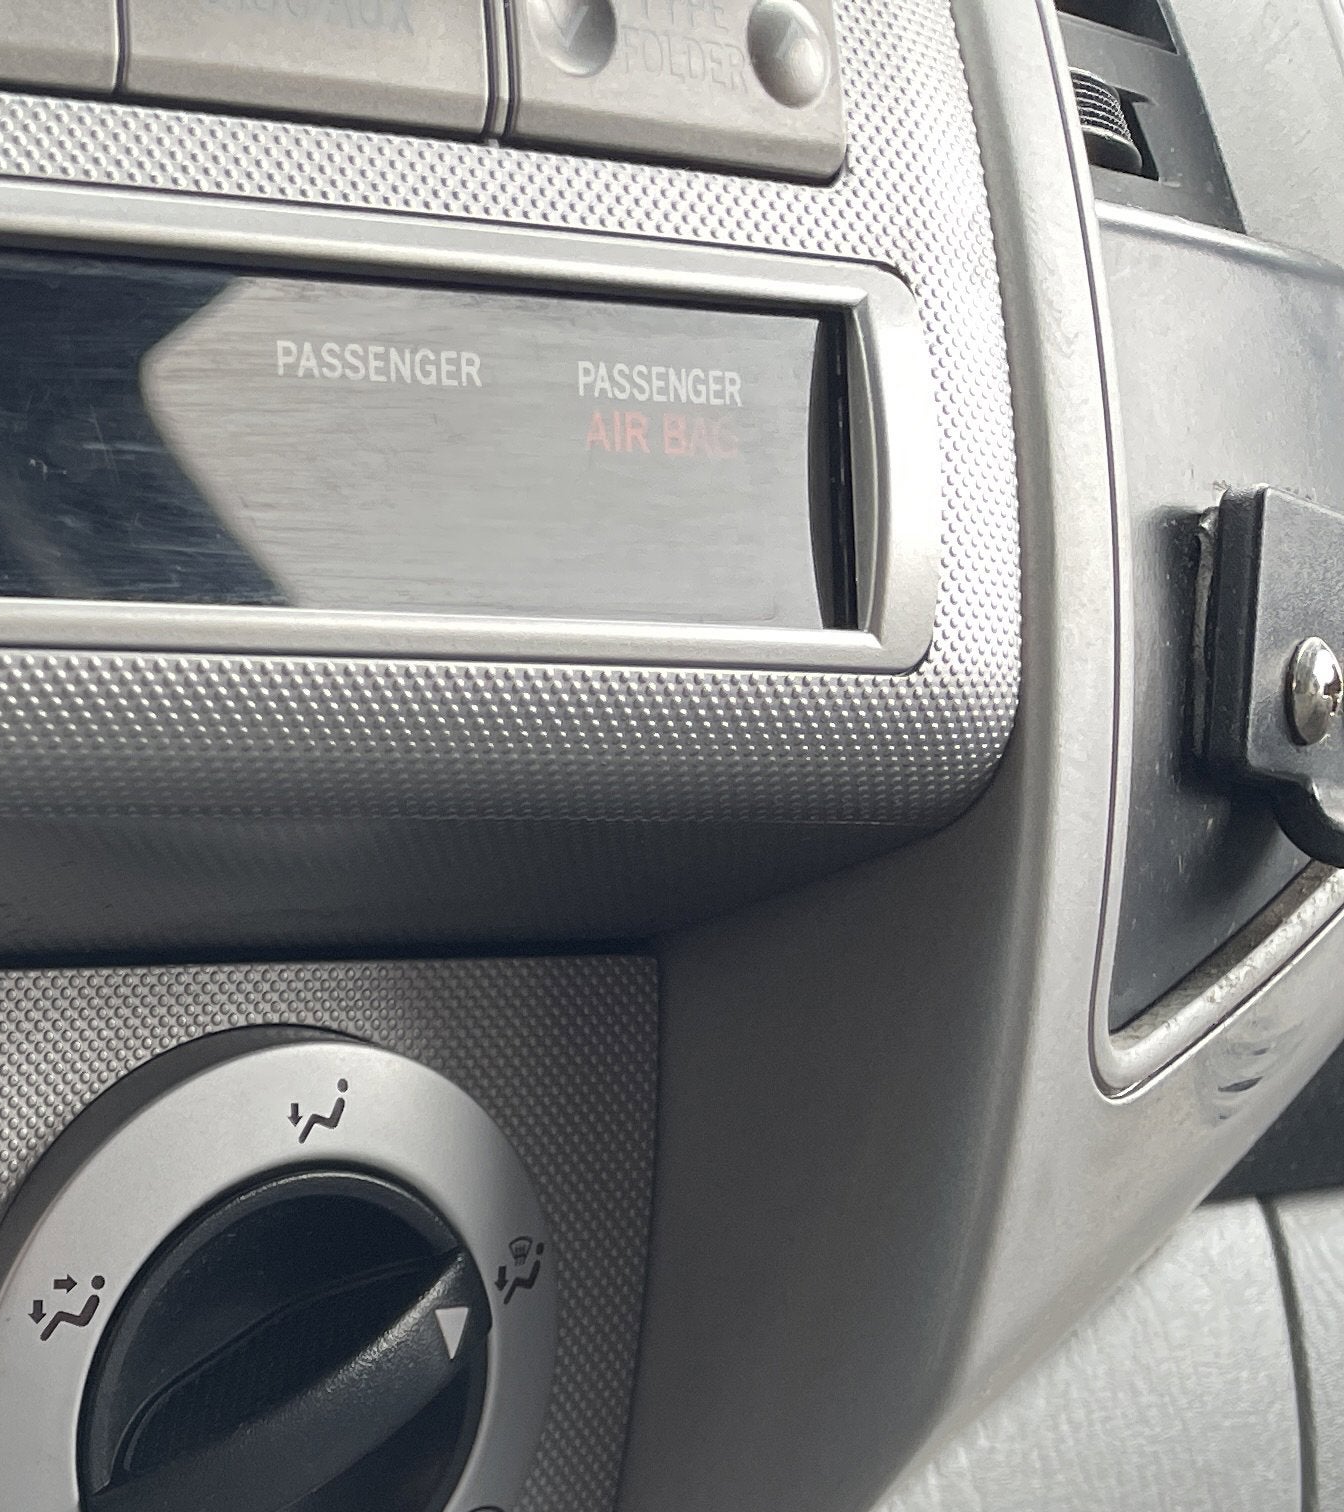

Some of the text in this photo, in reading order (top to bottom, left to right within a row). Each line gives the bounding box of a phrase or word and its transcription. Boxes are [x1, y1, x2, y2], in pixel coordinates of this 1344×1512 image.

[276, 340, 482, 387] PASSENGER
[577, 360, 743, 407] PASSENGER
[586, 411, 739, 459] AIR BAG
